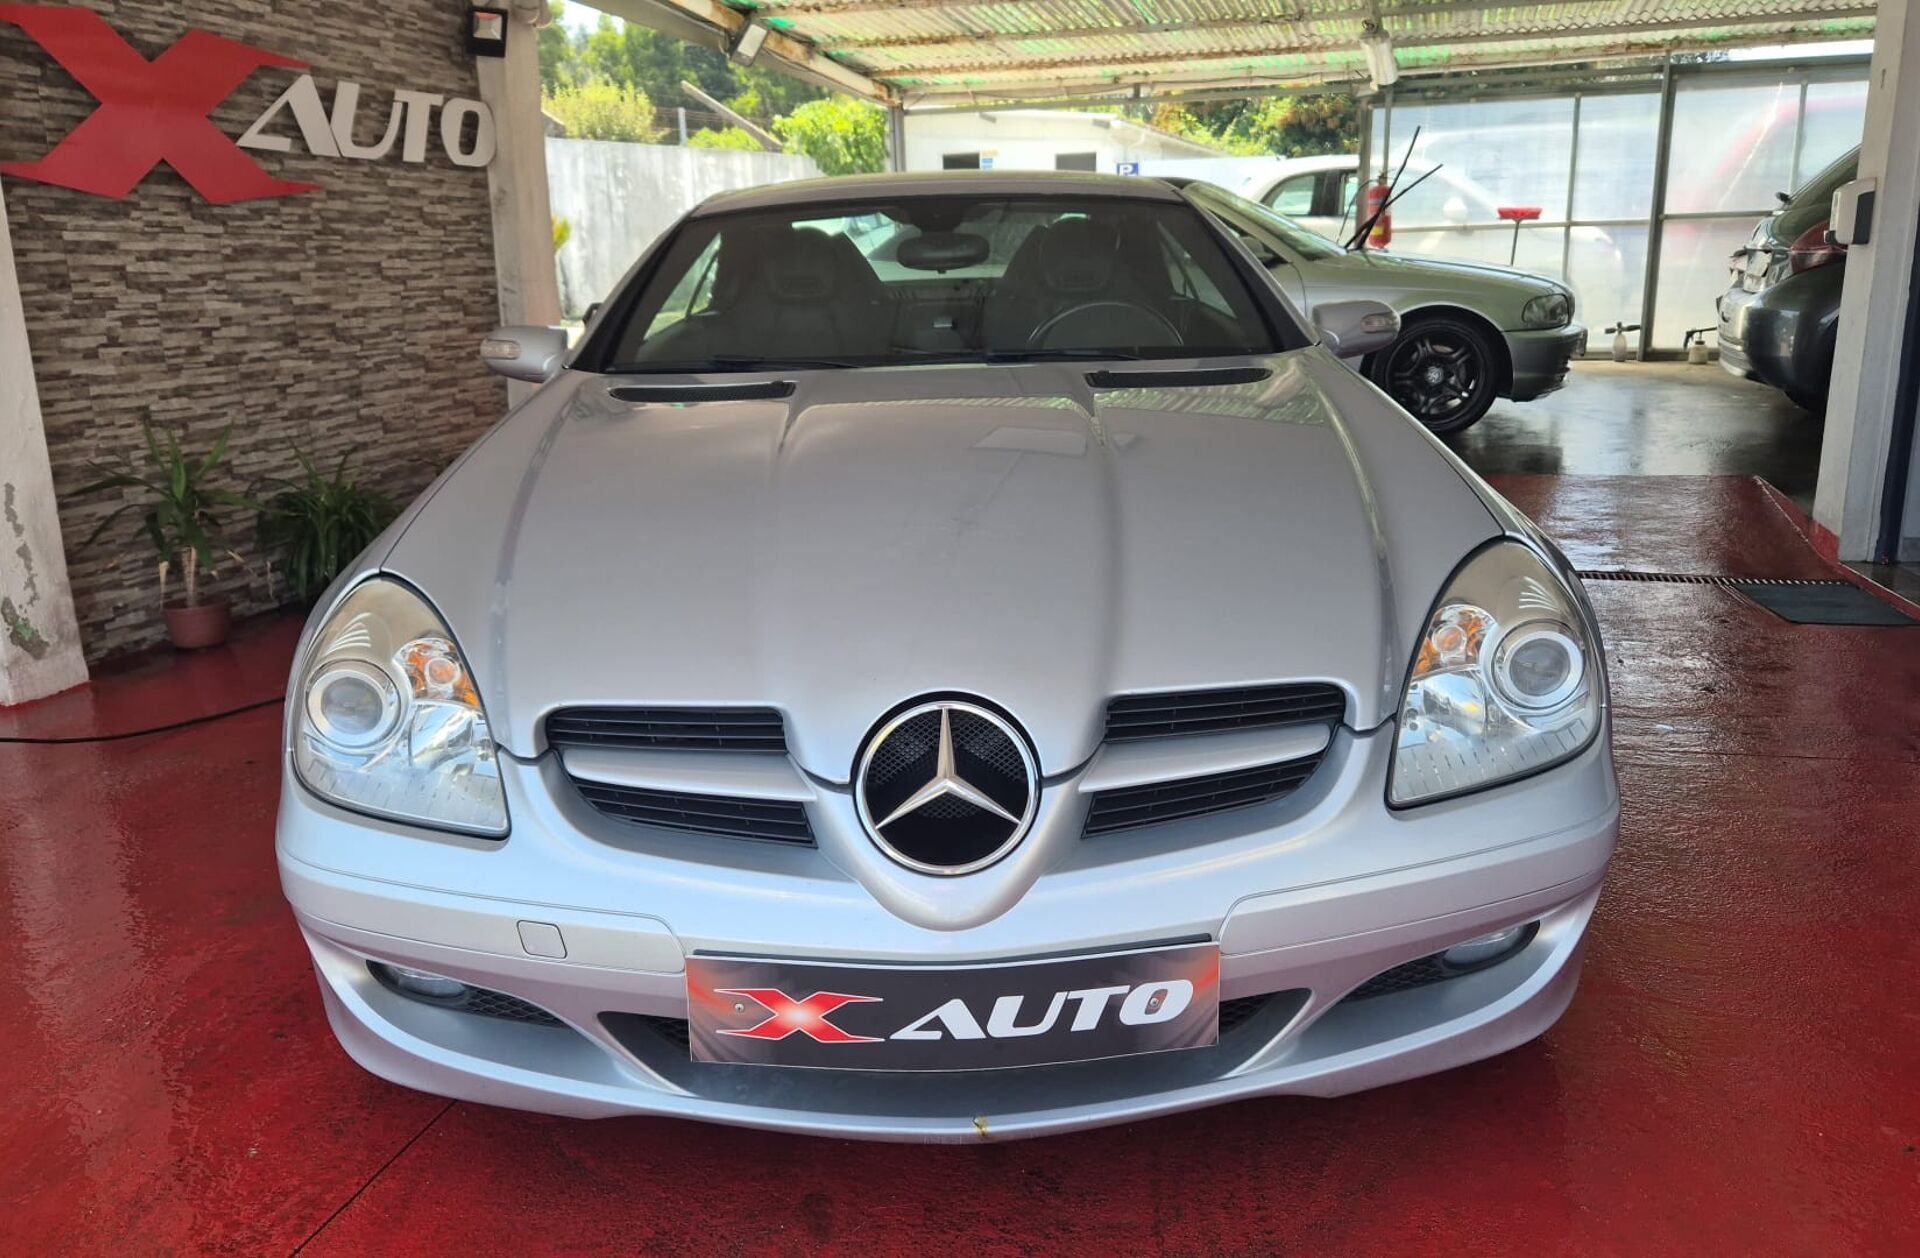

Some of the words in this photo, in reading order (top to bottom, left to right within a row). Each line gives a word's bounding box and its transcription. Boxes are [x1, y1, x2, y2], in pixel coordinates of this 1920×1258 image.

[0, 3, 324, 204] X
[236, 74, 496, 167] AUTO
[1118, 164, 1134, 177] P
[713, 988, 886, 1044] X
[889, 979, 1194, 1040] AUTO
